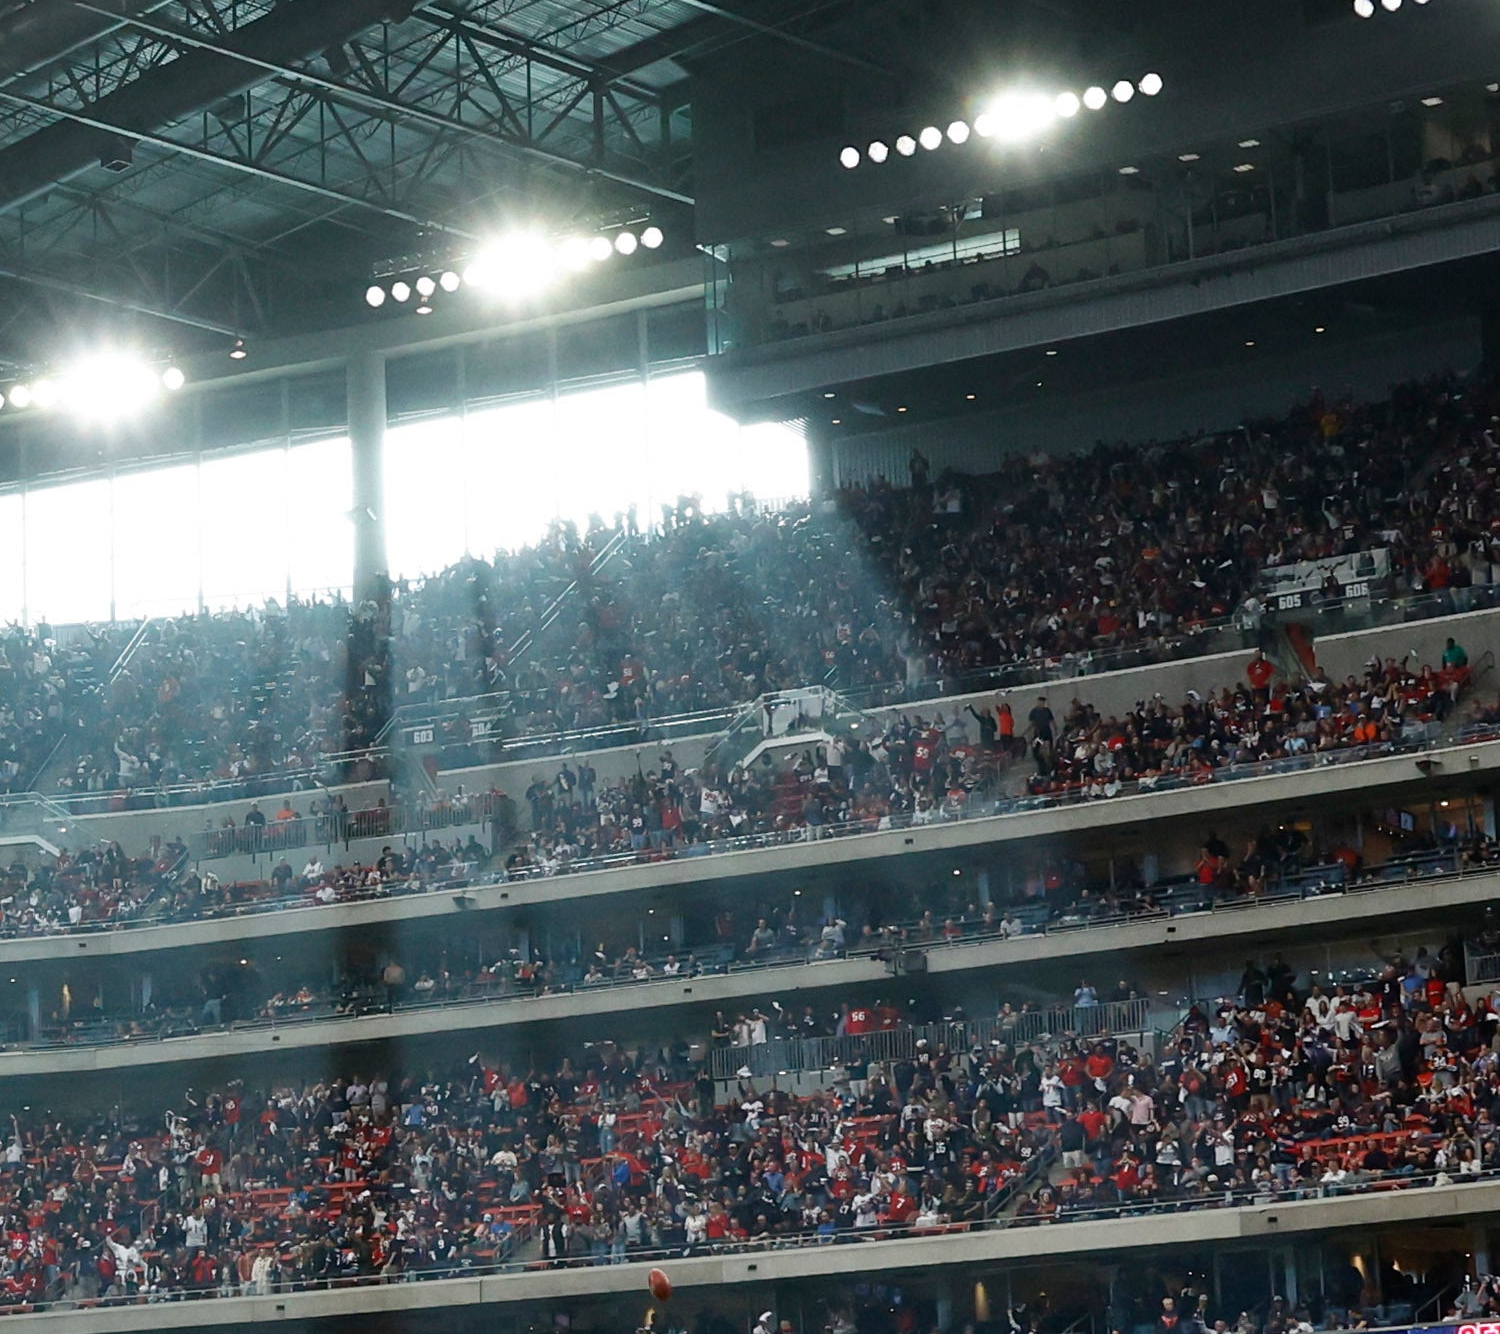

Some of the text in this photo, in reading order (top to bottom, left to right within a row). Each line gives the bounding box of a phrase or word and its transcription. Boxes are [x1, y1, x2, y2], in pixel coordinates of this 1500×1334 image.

[1345, 582, 1368, 597] 606
[1278, 594, 1302, 609] 605
[413, 731, 433, 743] 603
